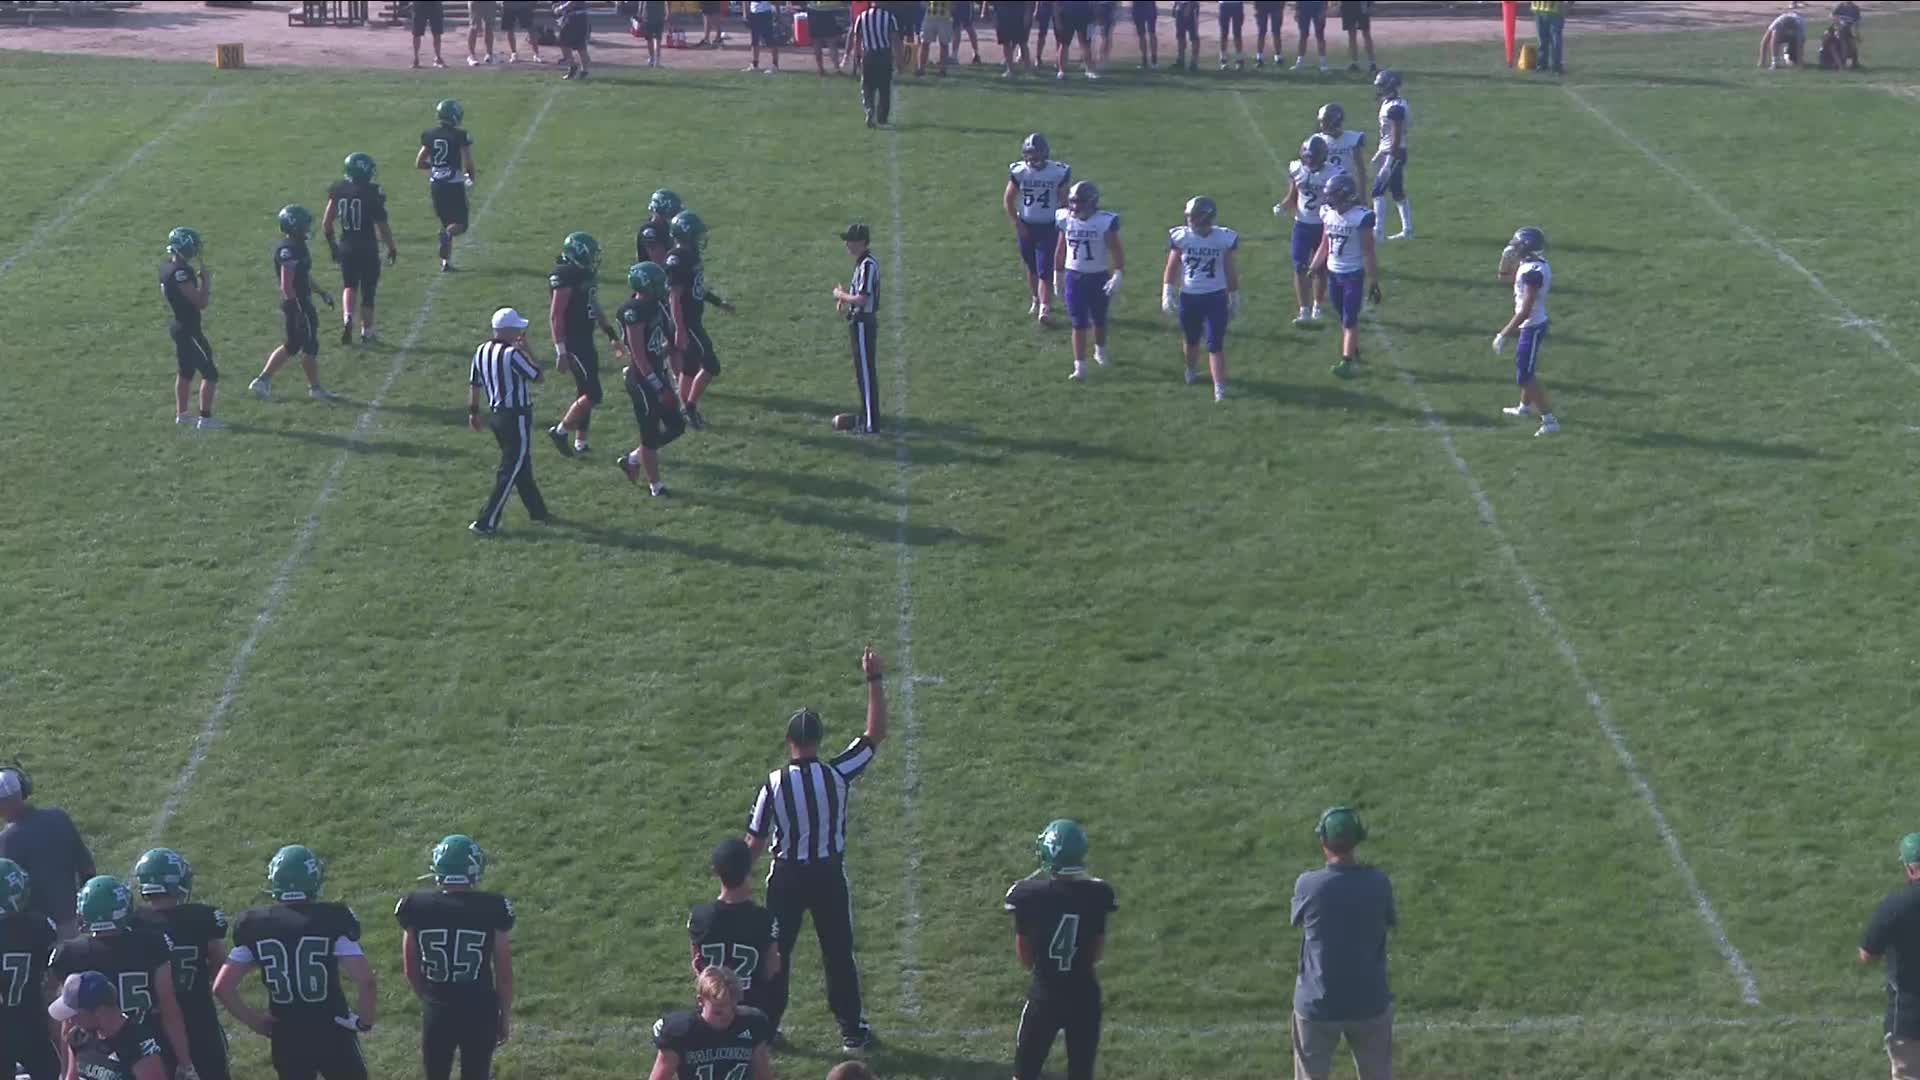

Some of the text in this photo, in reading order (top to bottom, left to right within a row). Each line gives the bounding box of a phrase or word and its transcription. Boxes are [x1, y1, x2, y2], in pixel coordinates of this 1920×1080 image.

[432, 138, 449, 166] 2
[1024, 188, 1050, 209] 54
[337, 197, 362, 232] 11
[1068, 238, 1095, 261] 71
[1185, 256, 1217, 279] 74
[418, 928, 486, 983] 55
[1048, 913, 1080, 972] 4
[256, 935, 329, 1004] 36
